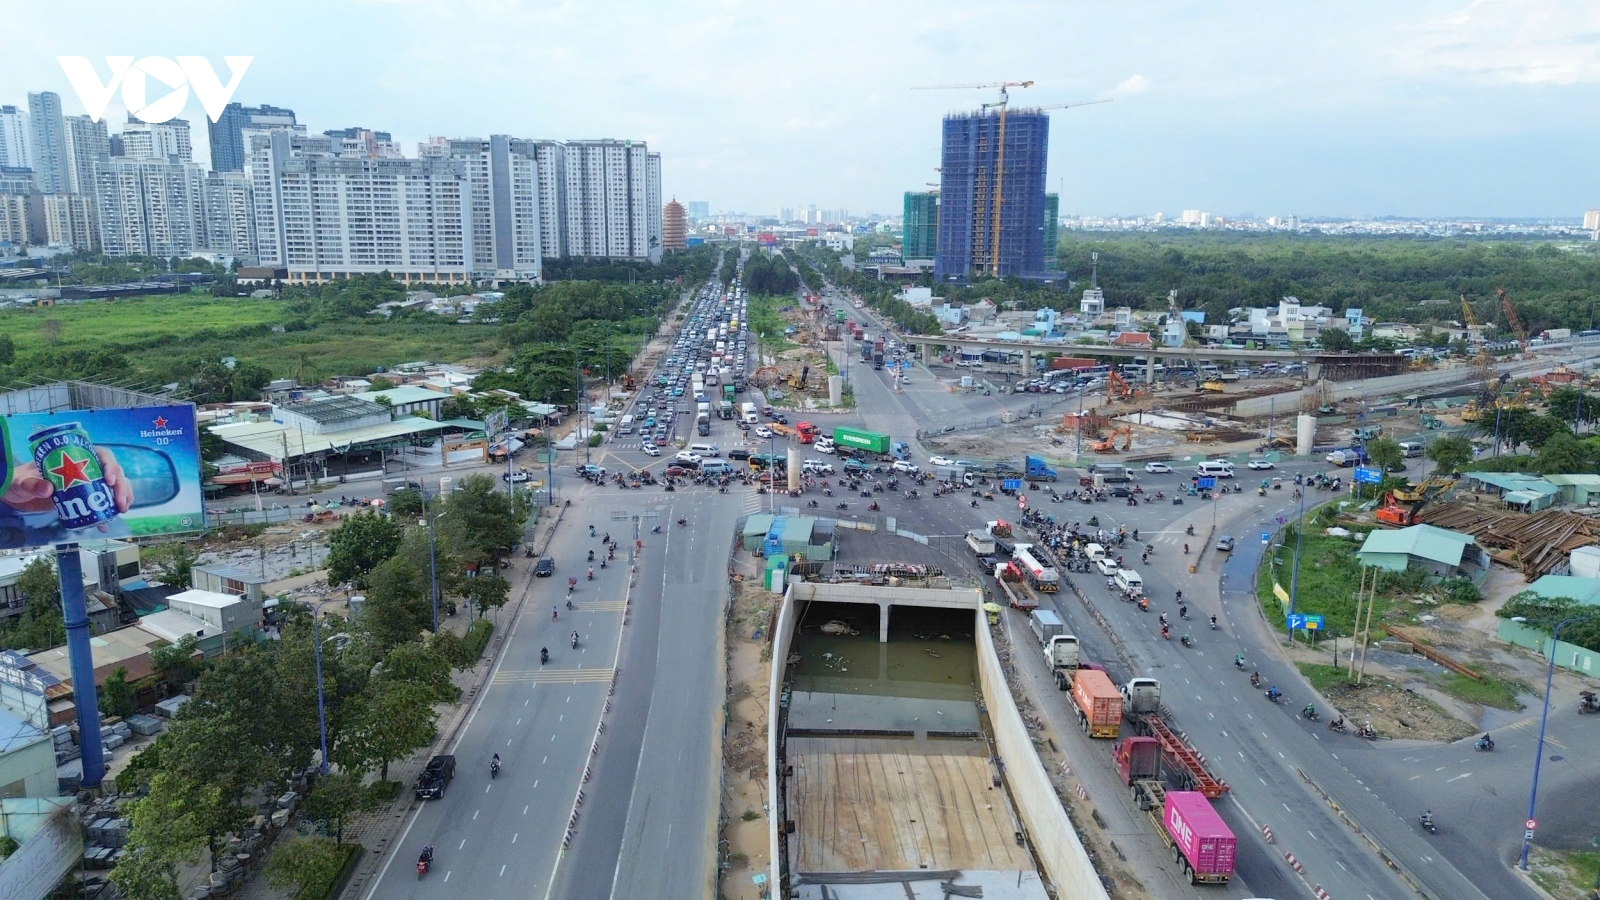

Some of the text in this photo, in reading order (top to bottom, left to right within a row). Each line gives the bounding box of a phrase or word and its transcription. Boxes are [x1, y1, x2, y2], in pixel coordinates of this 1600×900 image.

[140, 429, 183, 438] Heineken
[843, 434, 871, 445] EVERGREEN
[1170, 805, 1193, 850] ONE
